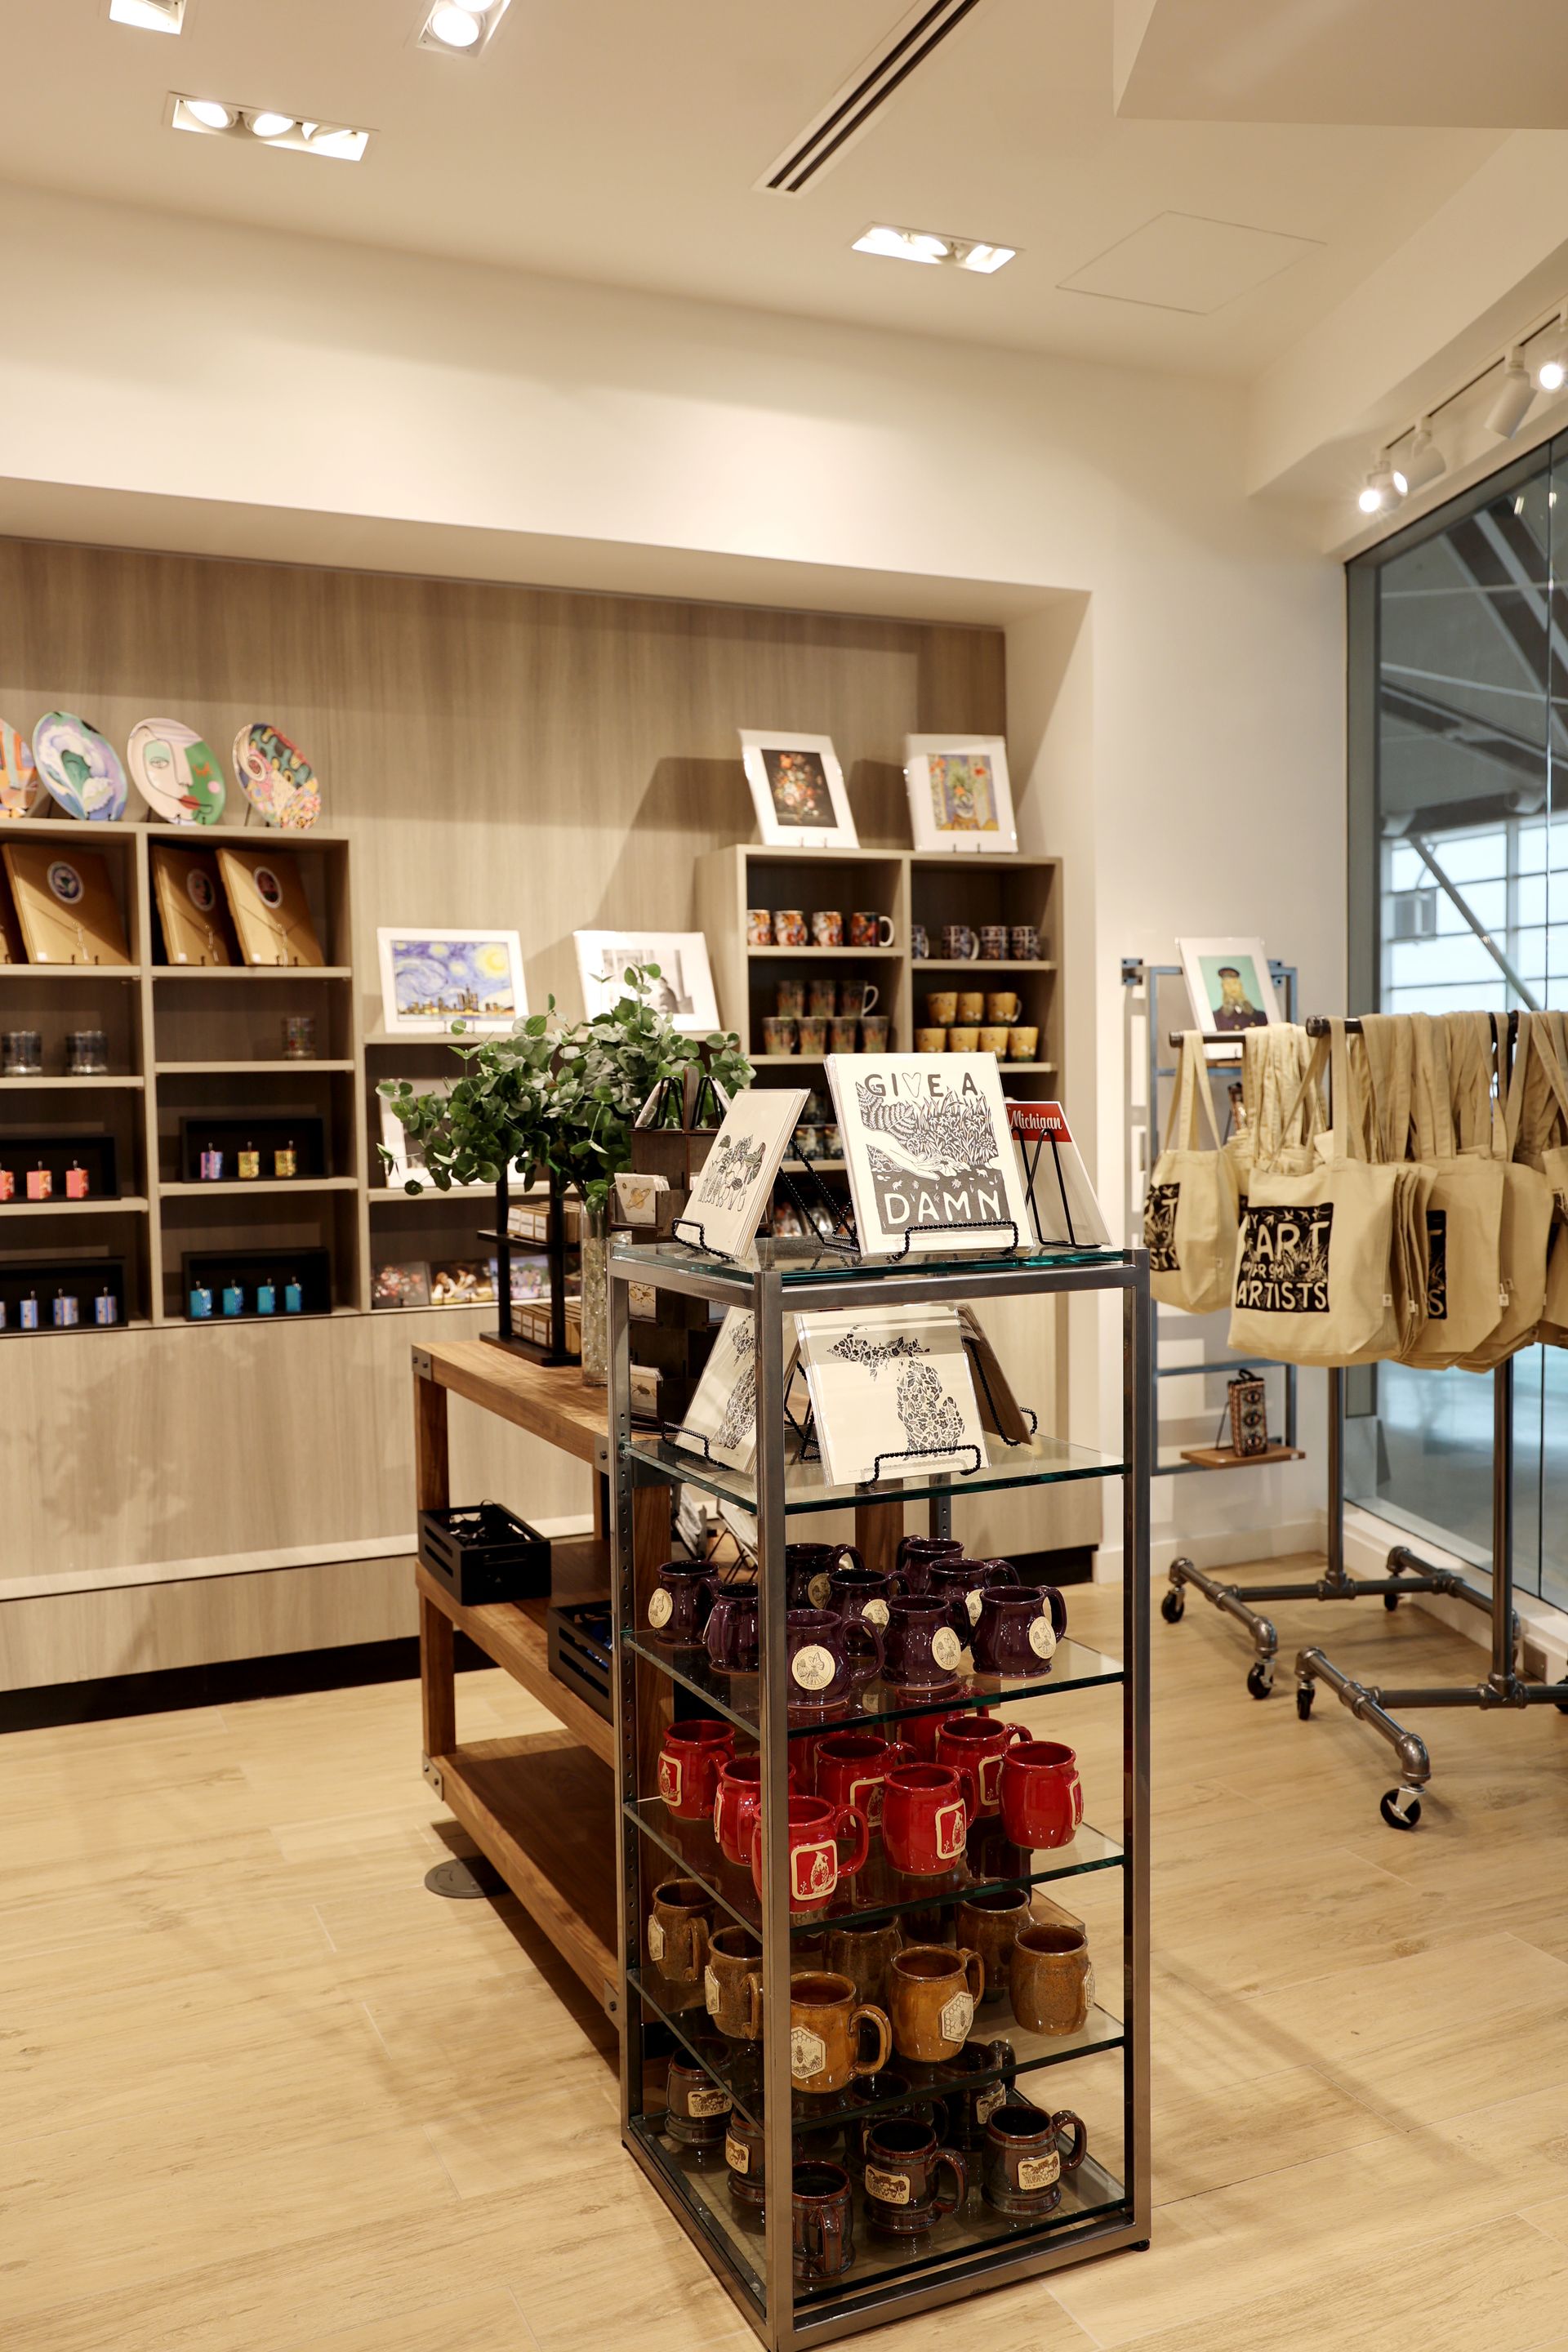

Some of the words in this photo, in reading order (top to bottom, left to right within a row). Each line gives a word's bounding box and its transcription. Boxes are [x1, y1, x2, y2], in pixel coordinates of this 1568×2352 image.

[961, 1072, 978, 1096] A
[1009, 1109, 1063, 1136] Michigan
[884, 1189, 1001, 1225] DAMN
[1256, 1221, 1330, 1262] ART
[1236, 1280, 1327, 1310] ARTISTS
